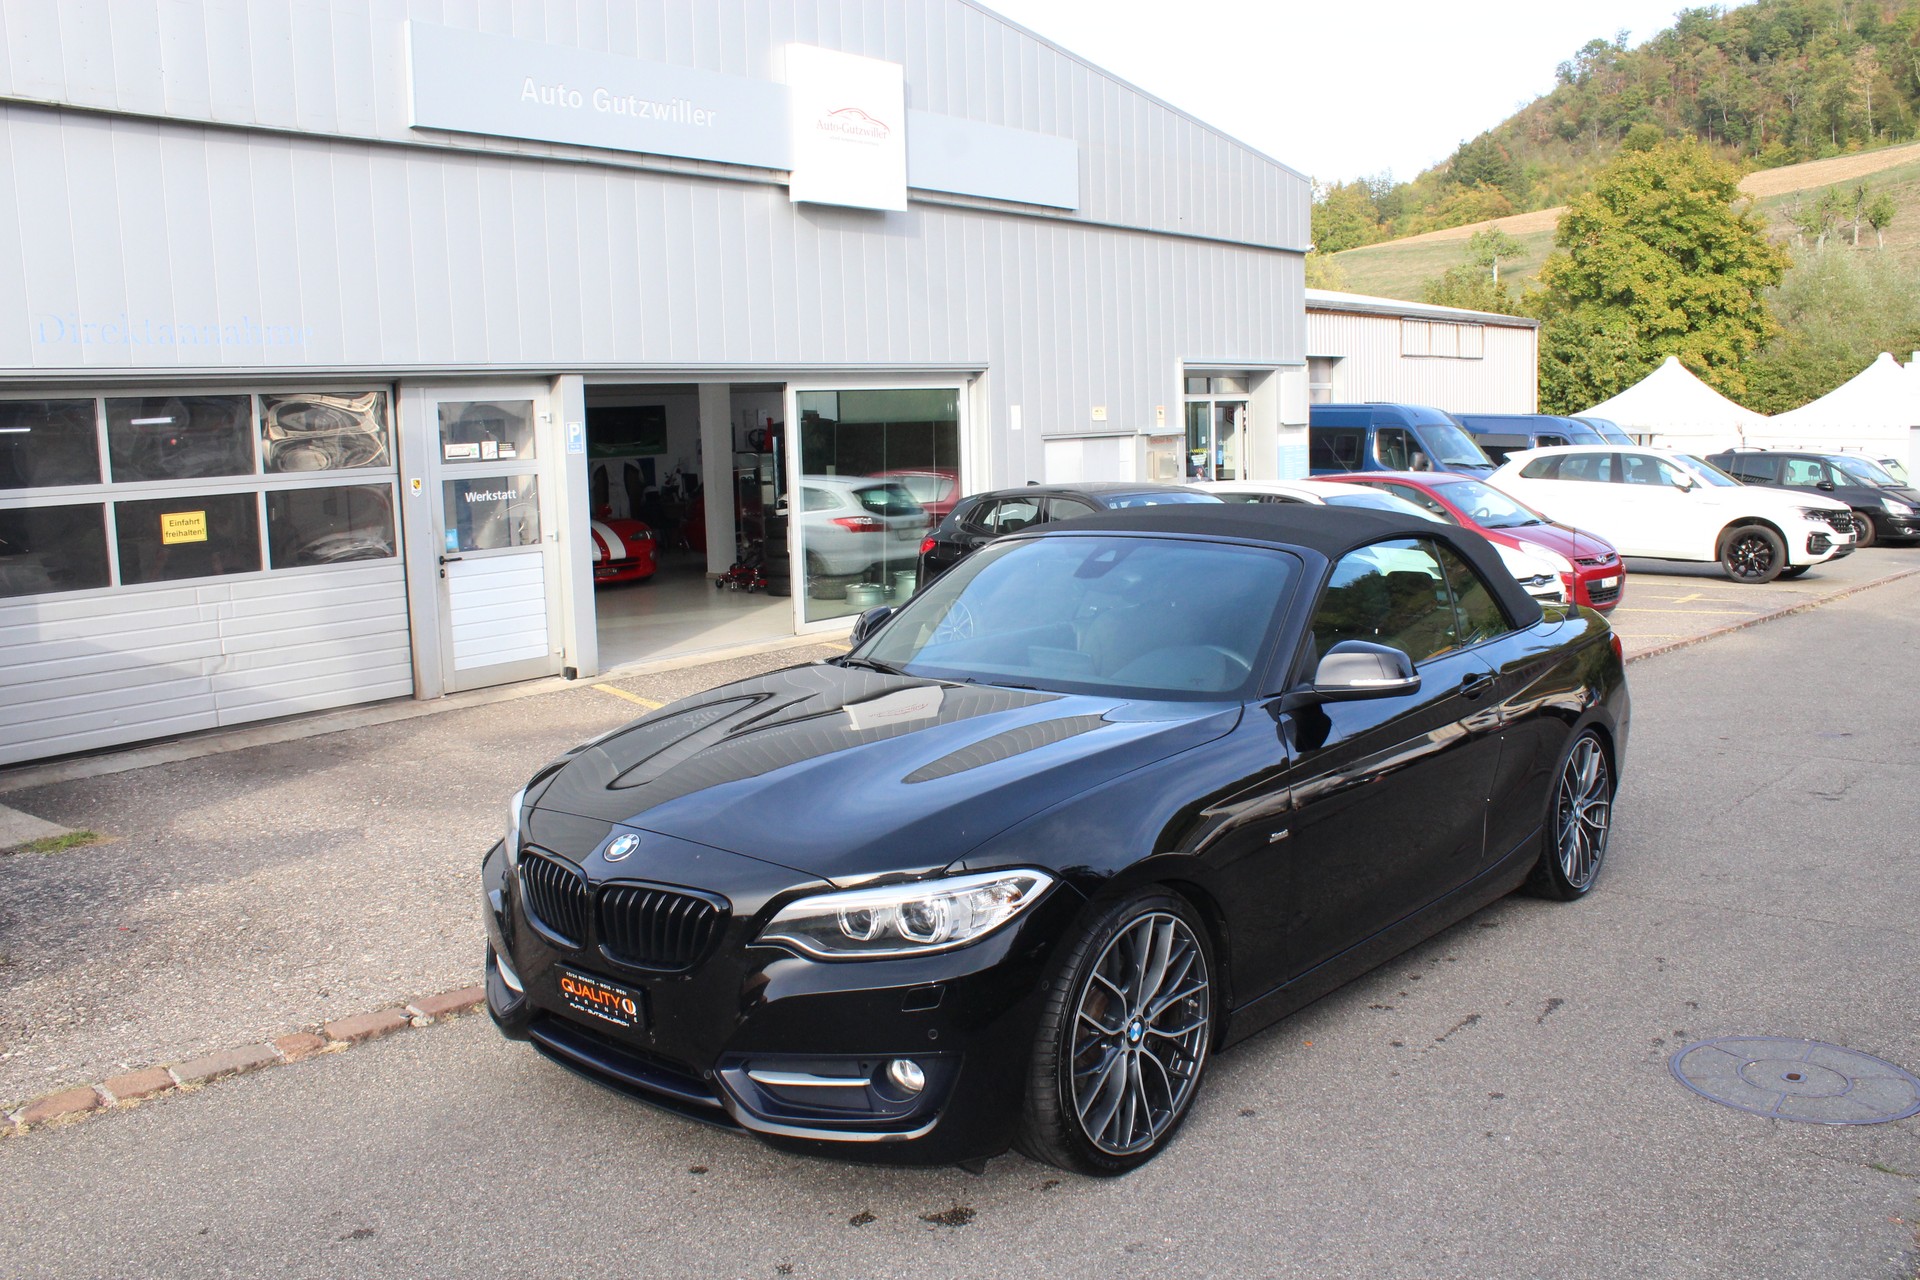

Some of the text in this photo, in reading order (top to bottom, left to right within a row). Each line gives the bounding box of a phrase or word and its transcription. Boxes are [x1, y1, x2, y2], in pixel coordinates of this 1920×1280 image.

[520, 76, 717, 127] Auto Gutzwiller
[816, 119, 887, 140] Auto-Gutzwiller
[35, 312, 314, 346] Direktannahme
[569, 423, 581, 443] P
[464, 489, 517, 503] Werkstatt
[165, 527, 205, 538] freihalten!
[169, 518, 200, 527] Einfahrt
[564, 992, 638, 1023] GARANTIE
